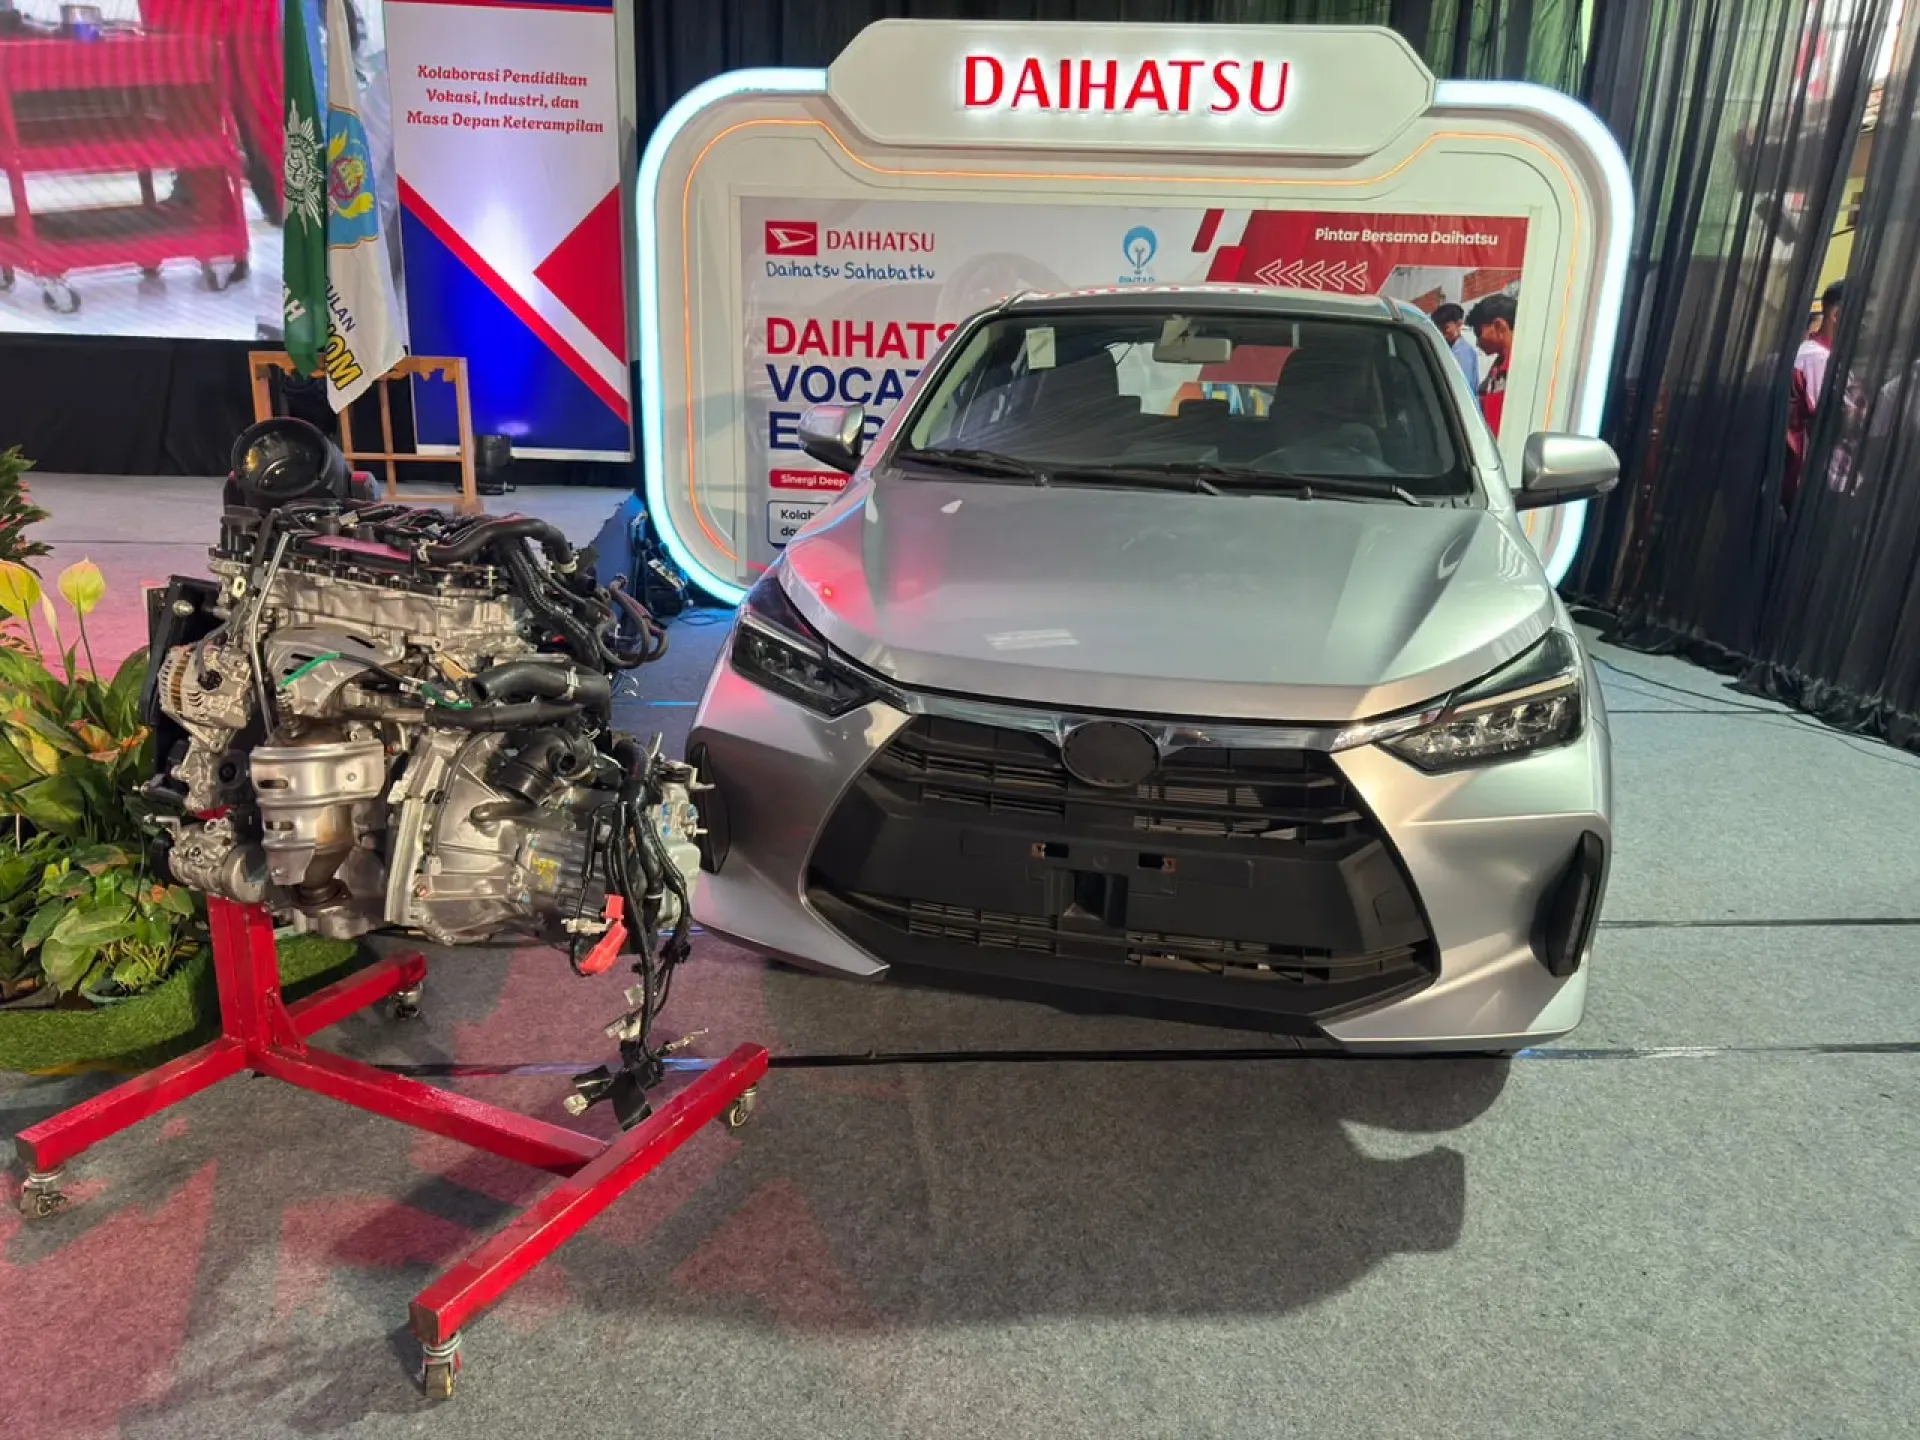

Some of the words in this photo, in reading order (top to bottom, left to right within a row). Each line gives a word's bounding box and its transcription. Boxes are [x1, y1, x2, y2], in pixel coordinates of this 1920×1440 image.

[417, 65, 500, 83] Kolaborasi
[503, 68, 588, 87] Pendidikan
[964, 55, 1290, 113] DAIHATSU
[426, 89, 481, 106] Vokasi,
[484, 91, 549, 110] Industri,
[551, 95, 580, 109] dan
[407, 110, 448, 126] Masa
[452, 112, 500, 130] Depan
[503, 115, 604, 135] Keterampilan
[826, 230, 935, 252] DAIHATSU
[1315, 227, 1359, 241] Pintar
[1361, 229, 1428, 244] Bersama
[1431, 230, 1499, 246] Daihatsu
[765, 260, 840, 279] Daihatsu
[844, 261, 936, 281] Sahabatku
[325, 277, 356, 332] ULAN
[765, 363, 921, 406] VOCA
[781, 474, 816, 487] Sinergi
[818, 475, 847, 487] Deep
